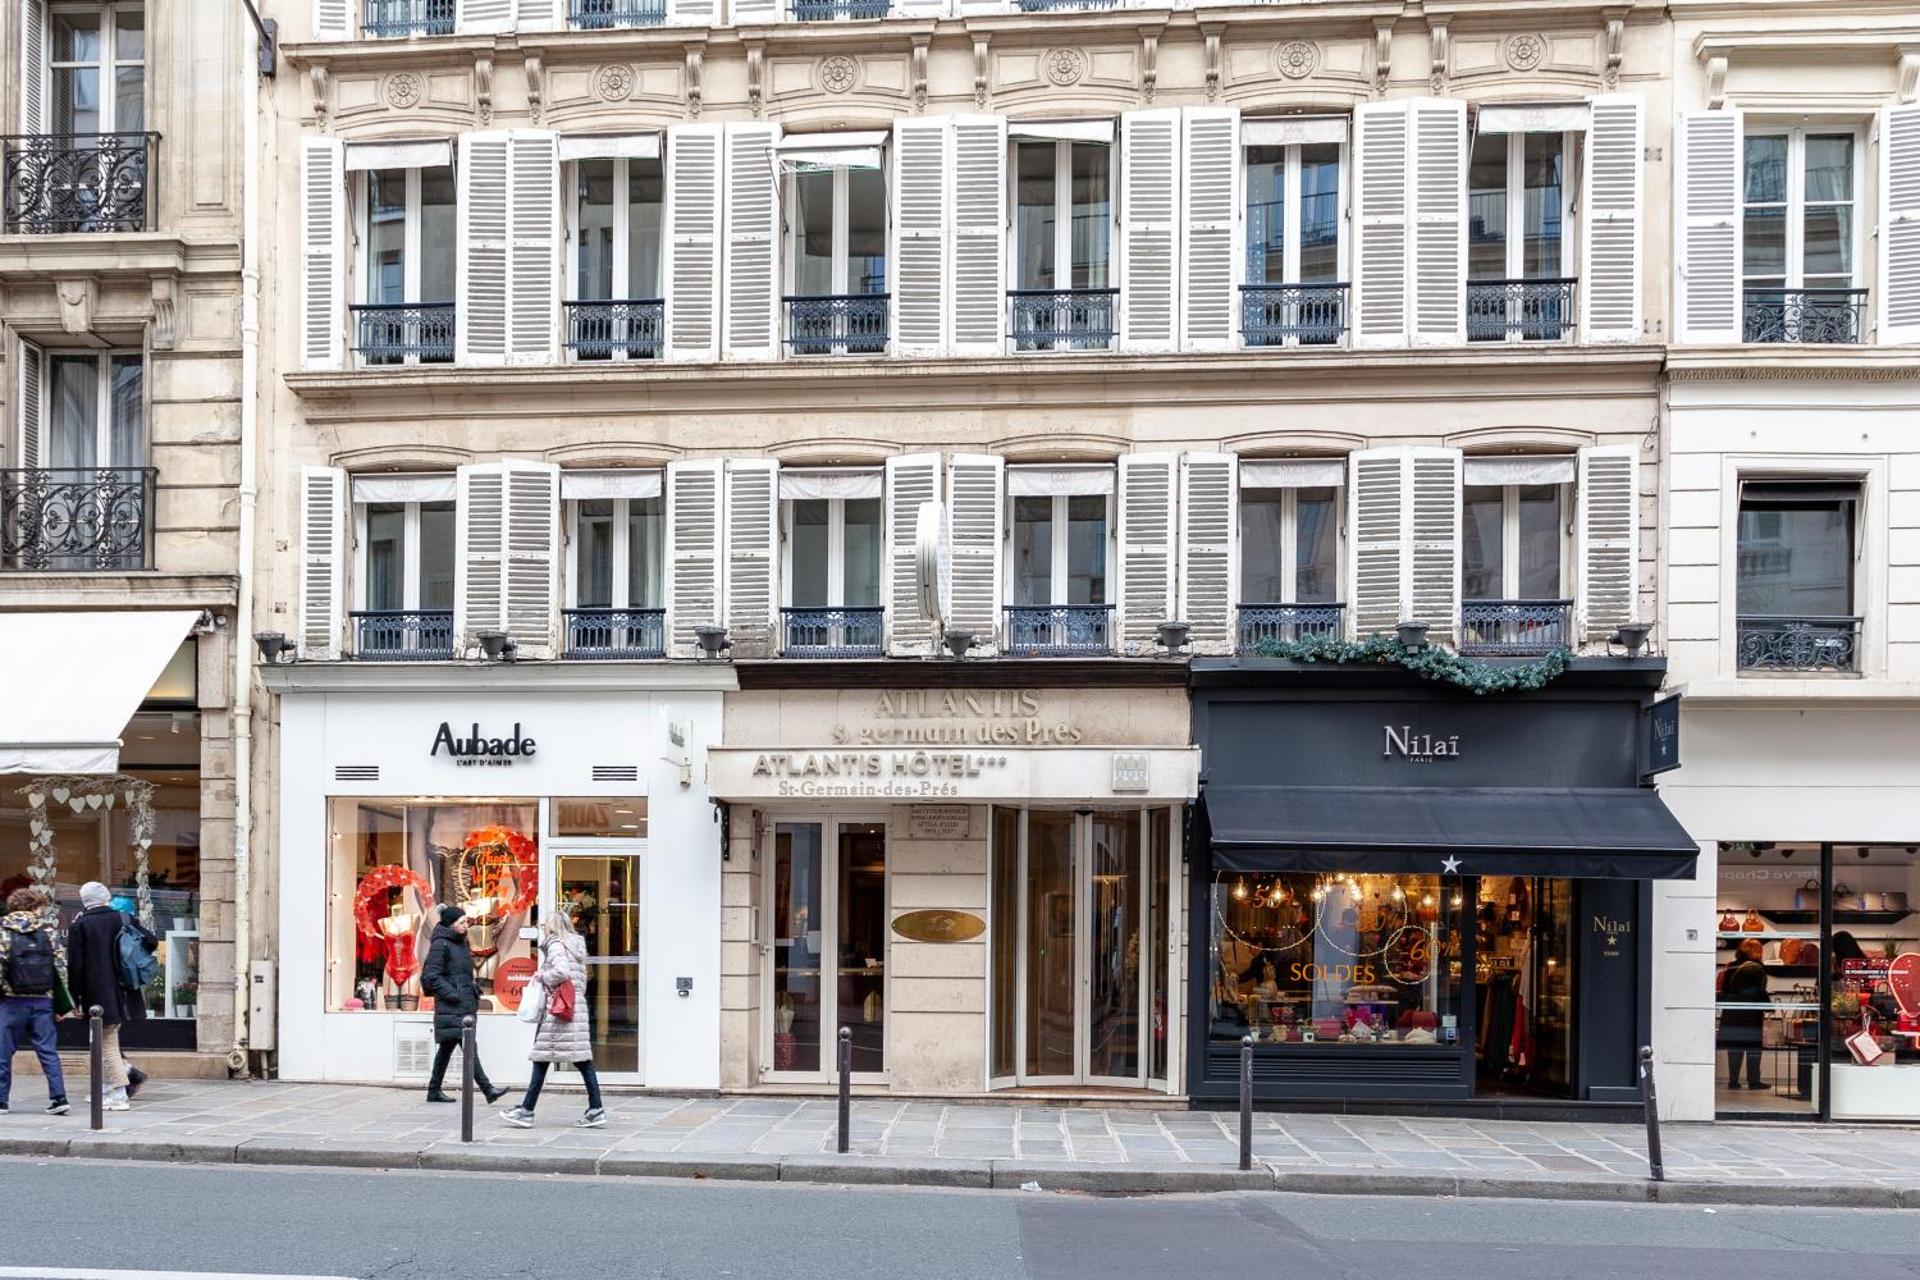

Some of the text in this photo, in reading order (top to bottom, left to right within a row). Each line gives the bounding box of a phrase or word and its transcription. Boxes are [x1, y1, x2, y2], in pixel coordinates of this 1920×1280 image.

[874, 689, 1041, 716] ATLANTIS
[430, 722, 537, 756] Aubade
[977, 719, 1018, 743] des
[1025, 718, 1082, 743] Prés
[1383, 725, 1460, 755] Nilaï
[753, 754, 882, 776] ATLANTIS
[778, 780, 959, 796] St-Germain-des-Prés
[1290, 963, 1376, 983] SOLDES
